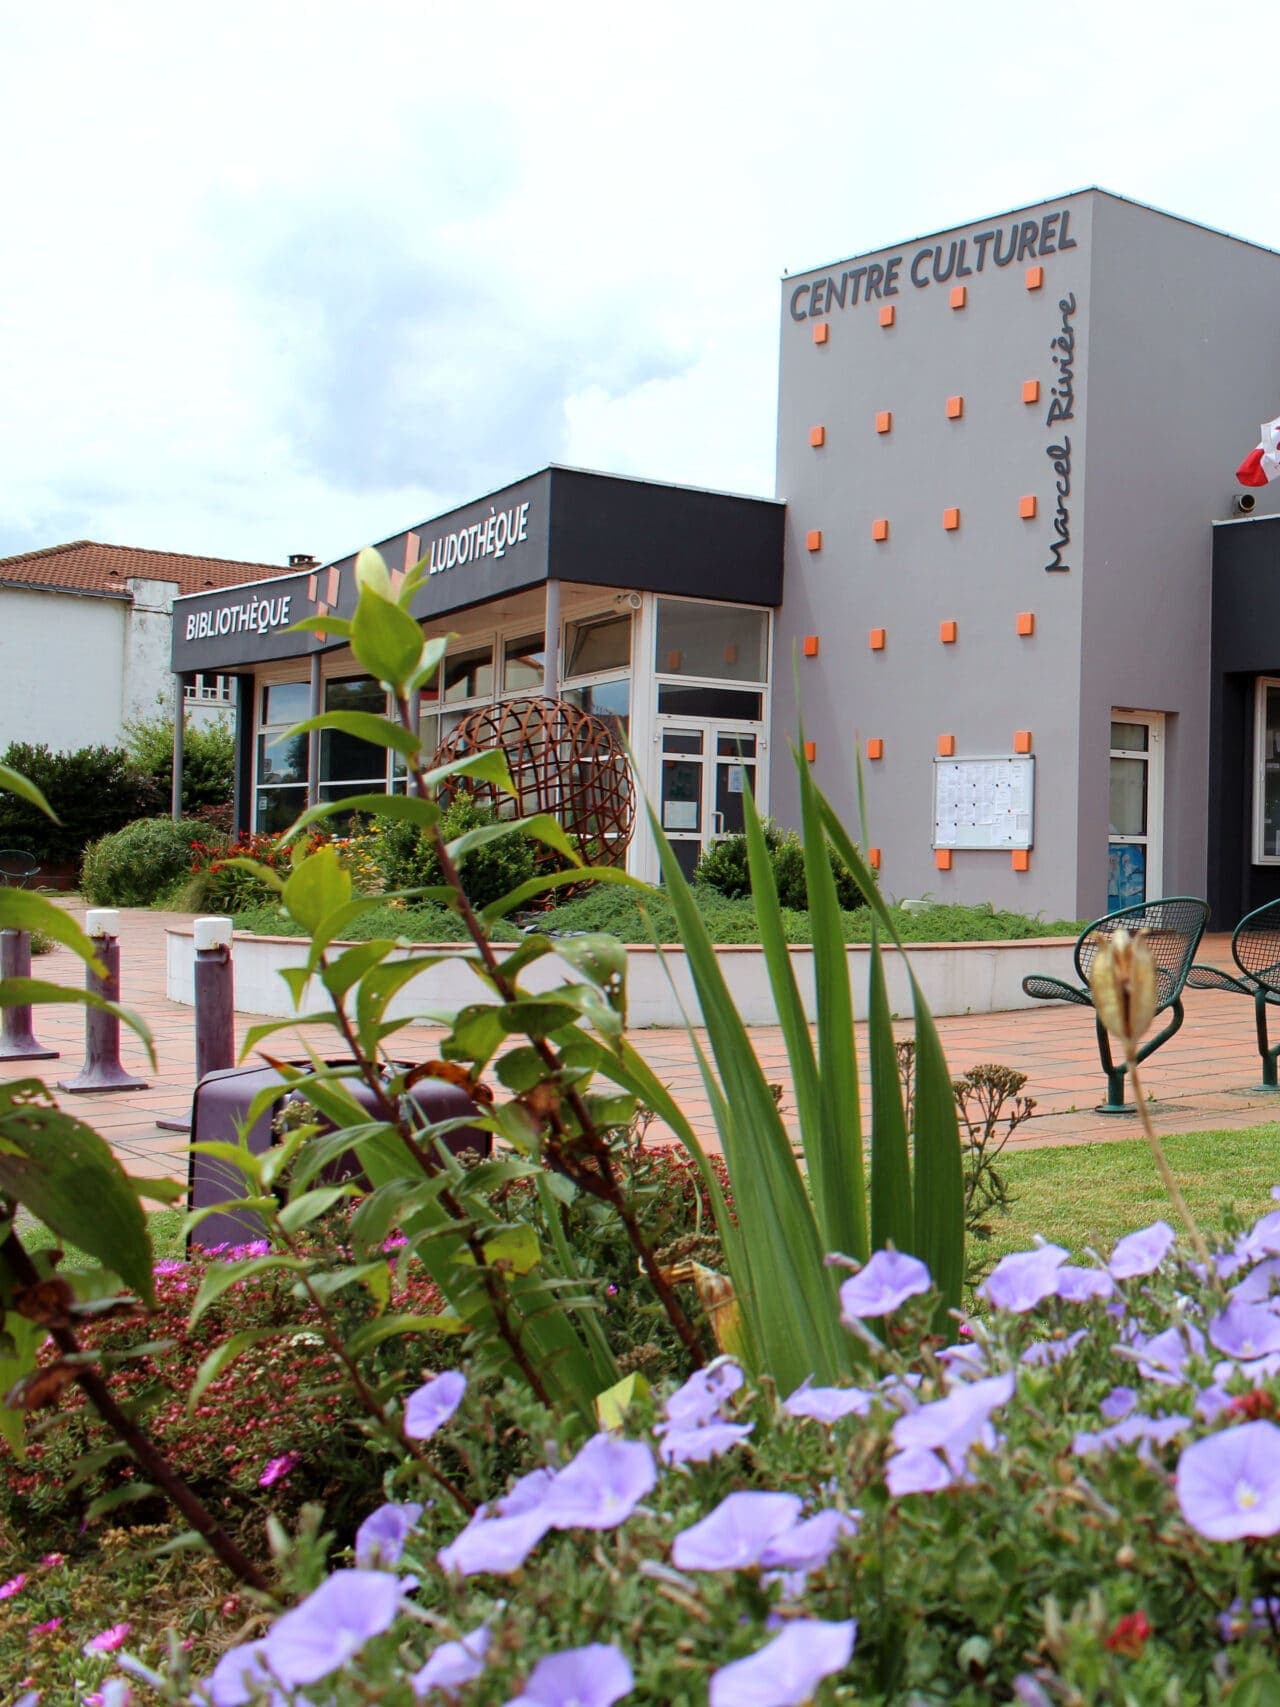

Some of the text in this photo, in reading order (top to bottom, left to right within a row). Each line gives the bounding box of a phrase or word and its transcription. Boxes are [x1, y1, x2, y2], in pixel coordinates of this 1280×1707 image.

[790, 210, 1077, 321] CENTRE CULTUREL
[1045, 292, 1076, 573] Marcel Rivière
[429, 502, 530, 575] LUDOTHÈQUE
[185, 595, 291, 641] BIBLIOTHÈQUE
